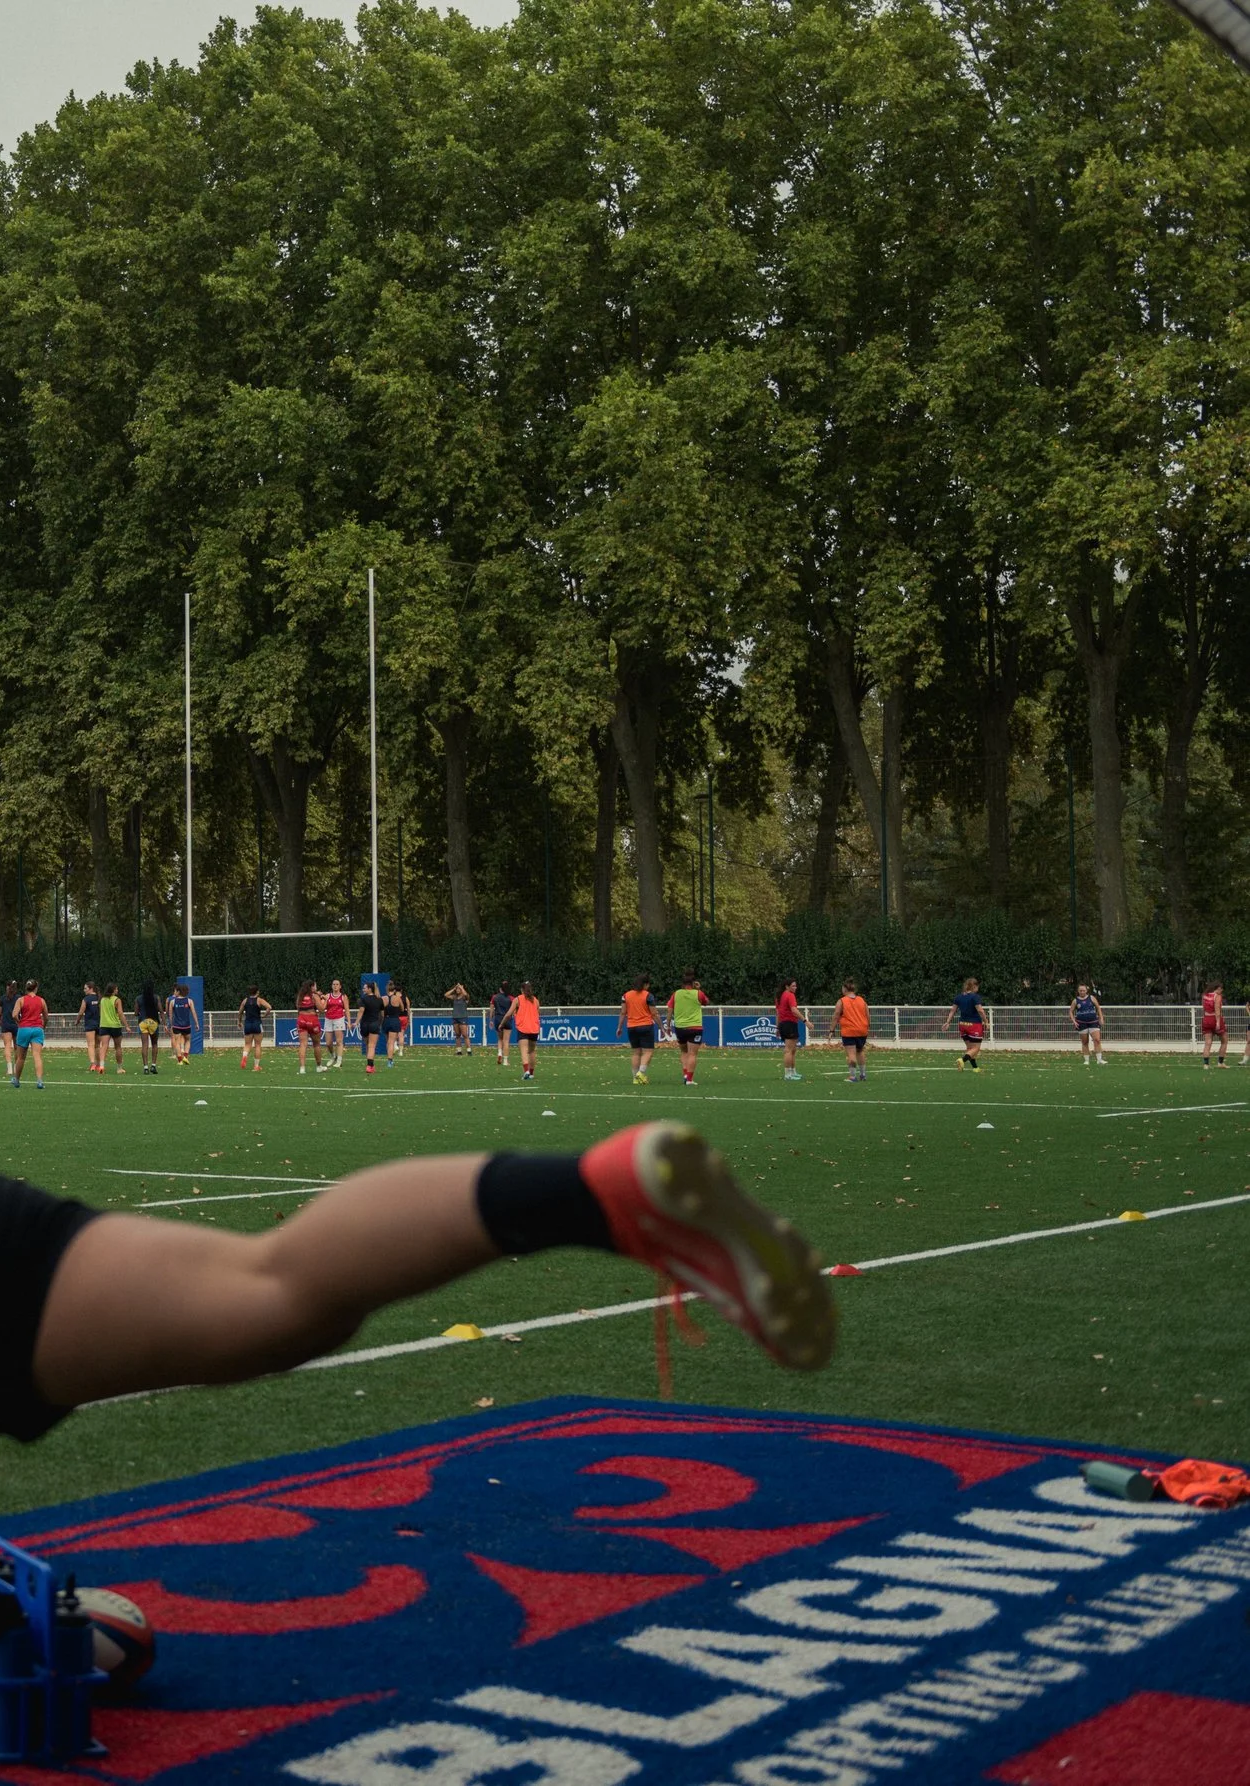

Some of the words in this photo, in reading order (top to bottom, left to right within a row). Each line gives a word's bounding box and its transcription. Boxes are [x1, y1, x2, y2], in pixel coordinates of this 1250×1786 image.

[537, 1026, 599, 1041] LAGNAC
[281, 1476, 1234, 1786] BLAGNAC
[1022, 1573, 1240, 1655] CLUB
